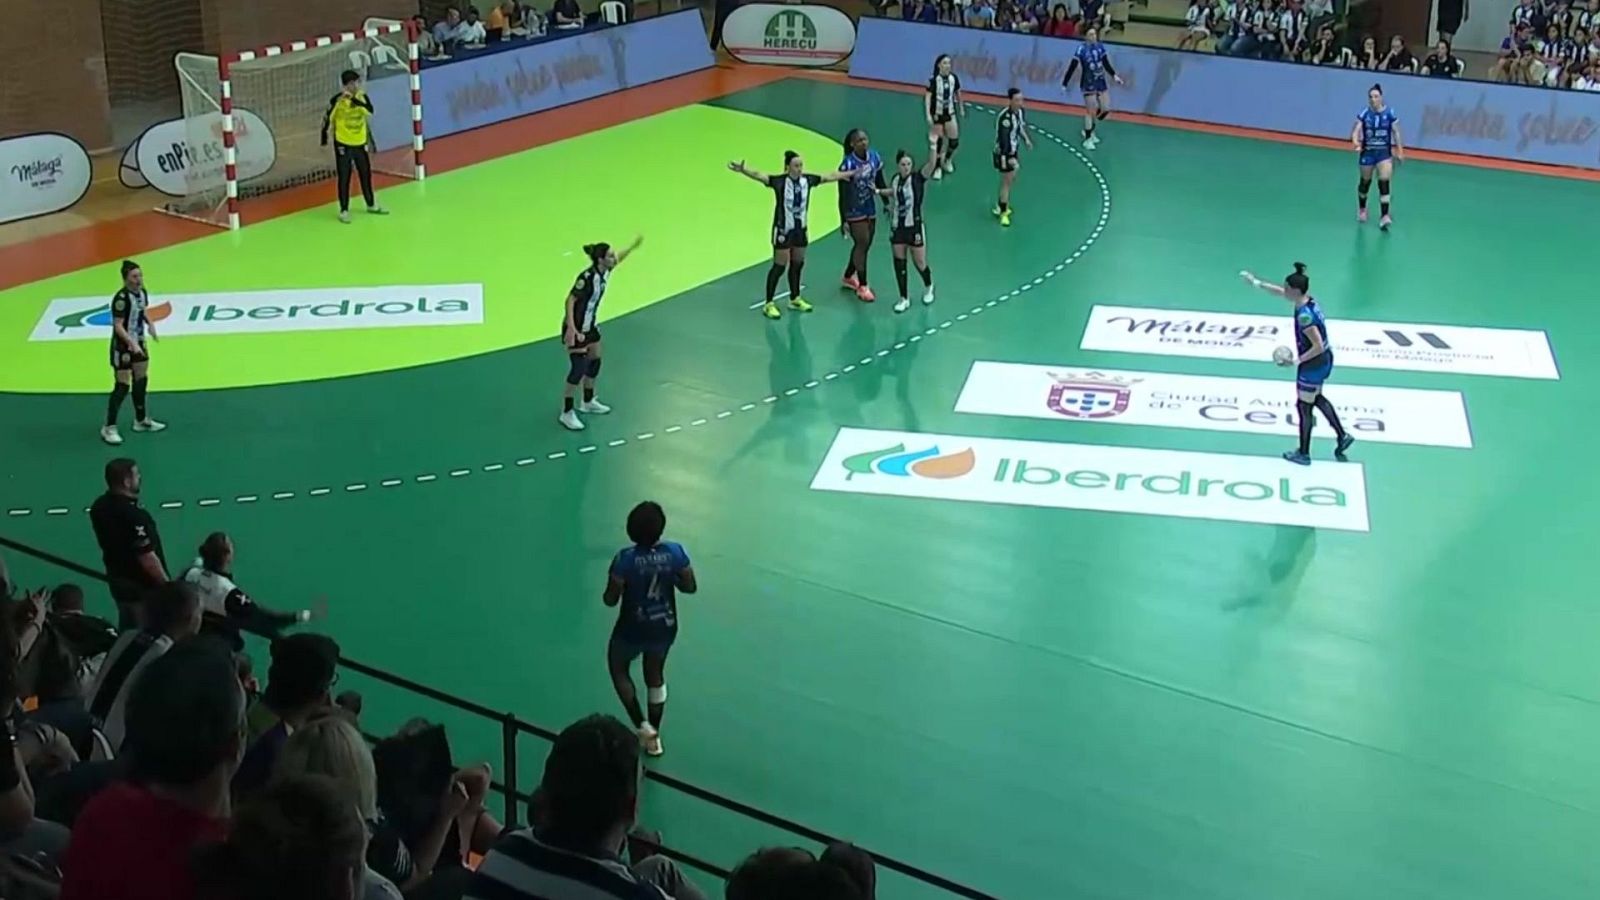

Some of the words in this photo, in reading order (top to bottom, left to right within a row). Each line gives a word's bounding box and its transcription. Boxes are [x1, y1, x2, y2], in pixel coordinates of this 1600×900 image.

[763, 38, 816, 50] HERECU
[11, 154, 63, 182] Málaga
[188, 297, 469, 321] Iberdrola
[1107, 316, 1279, 341] Málaga
[1187, 339, 1244, 347] MODA
[1149, 401, 1181, 409] de
[1150, 391, 1239, 404] Ciudad
[994, 458, 1347, 507] Iberdrola
[647, 572, 663, 601] 4
